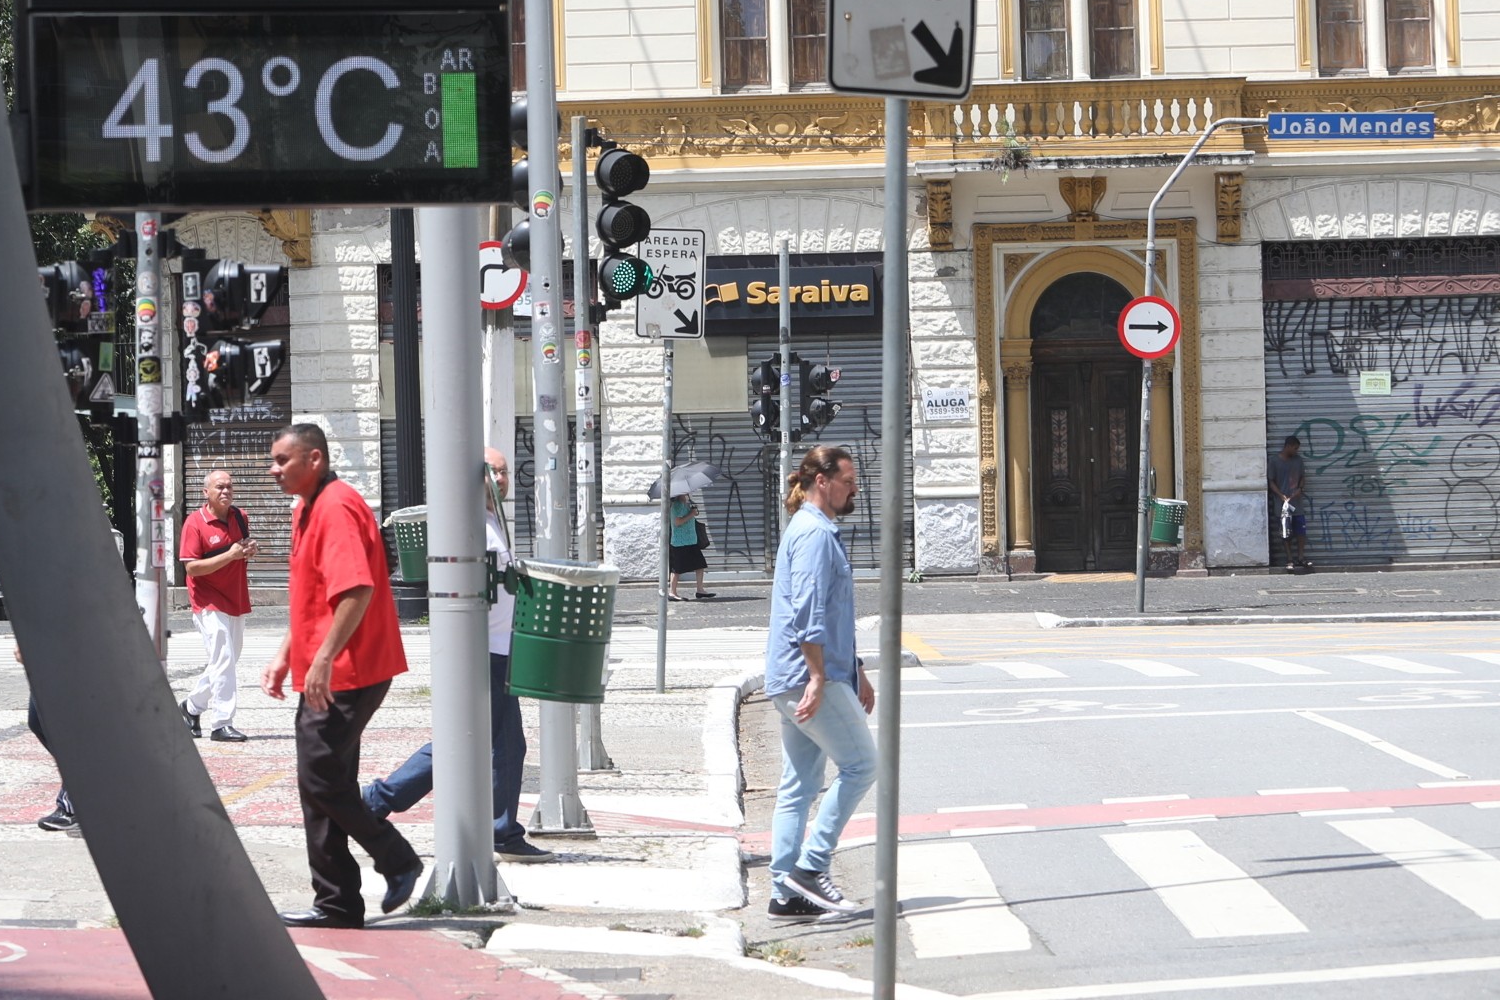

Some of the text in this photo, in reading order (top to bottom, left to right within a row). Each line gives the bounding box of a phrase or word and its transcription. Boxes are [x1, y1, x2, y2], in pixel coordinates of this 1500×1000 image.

[440, 48, 474, 71] AR
[101, 55, 405, 164] 43°C
[1273, 117, 1431, 136] João Mendes
[683, 237, 699, 246] DE
[646, 249, 697, 260] ESPERA
[746, 279, 869, 305] Saraiva
[927, 398, 965, 407] ALUGA
